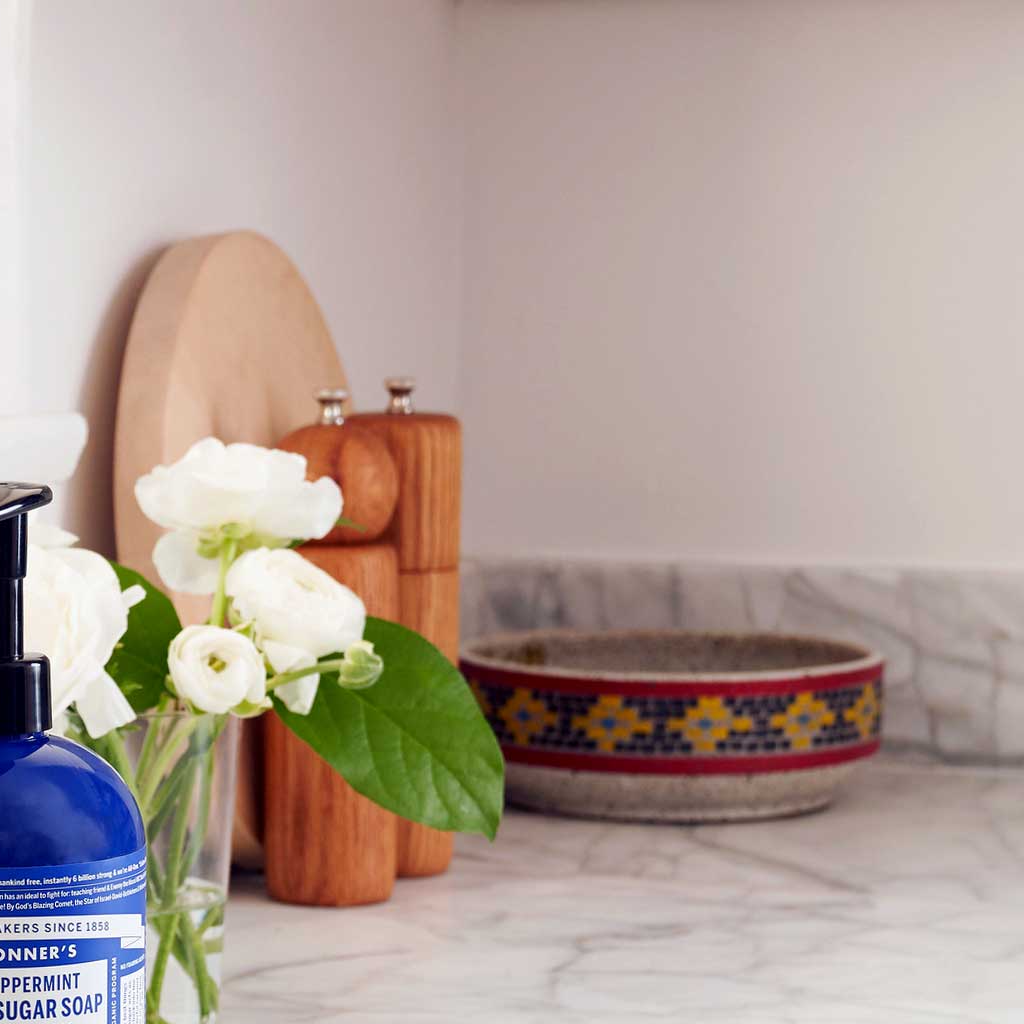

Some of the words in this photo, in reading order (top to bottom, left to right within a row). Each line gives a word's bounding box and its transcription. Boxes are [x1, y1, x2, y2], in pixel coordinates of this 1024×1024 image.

[27, 878, 42, 886] free,
[43, 876, 71, 884] instantly
[44, 922, 82, 933] SINCE
[86, 921, 110, 932] 1858
[61, 993, 103, 1016] SOAP
